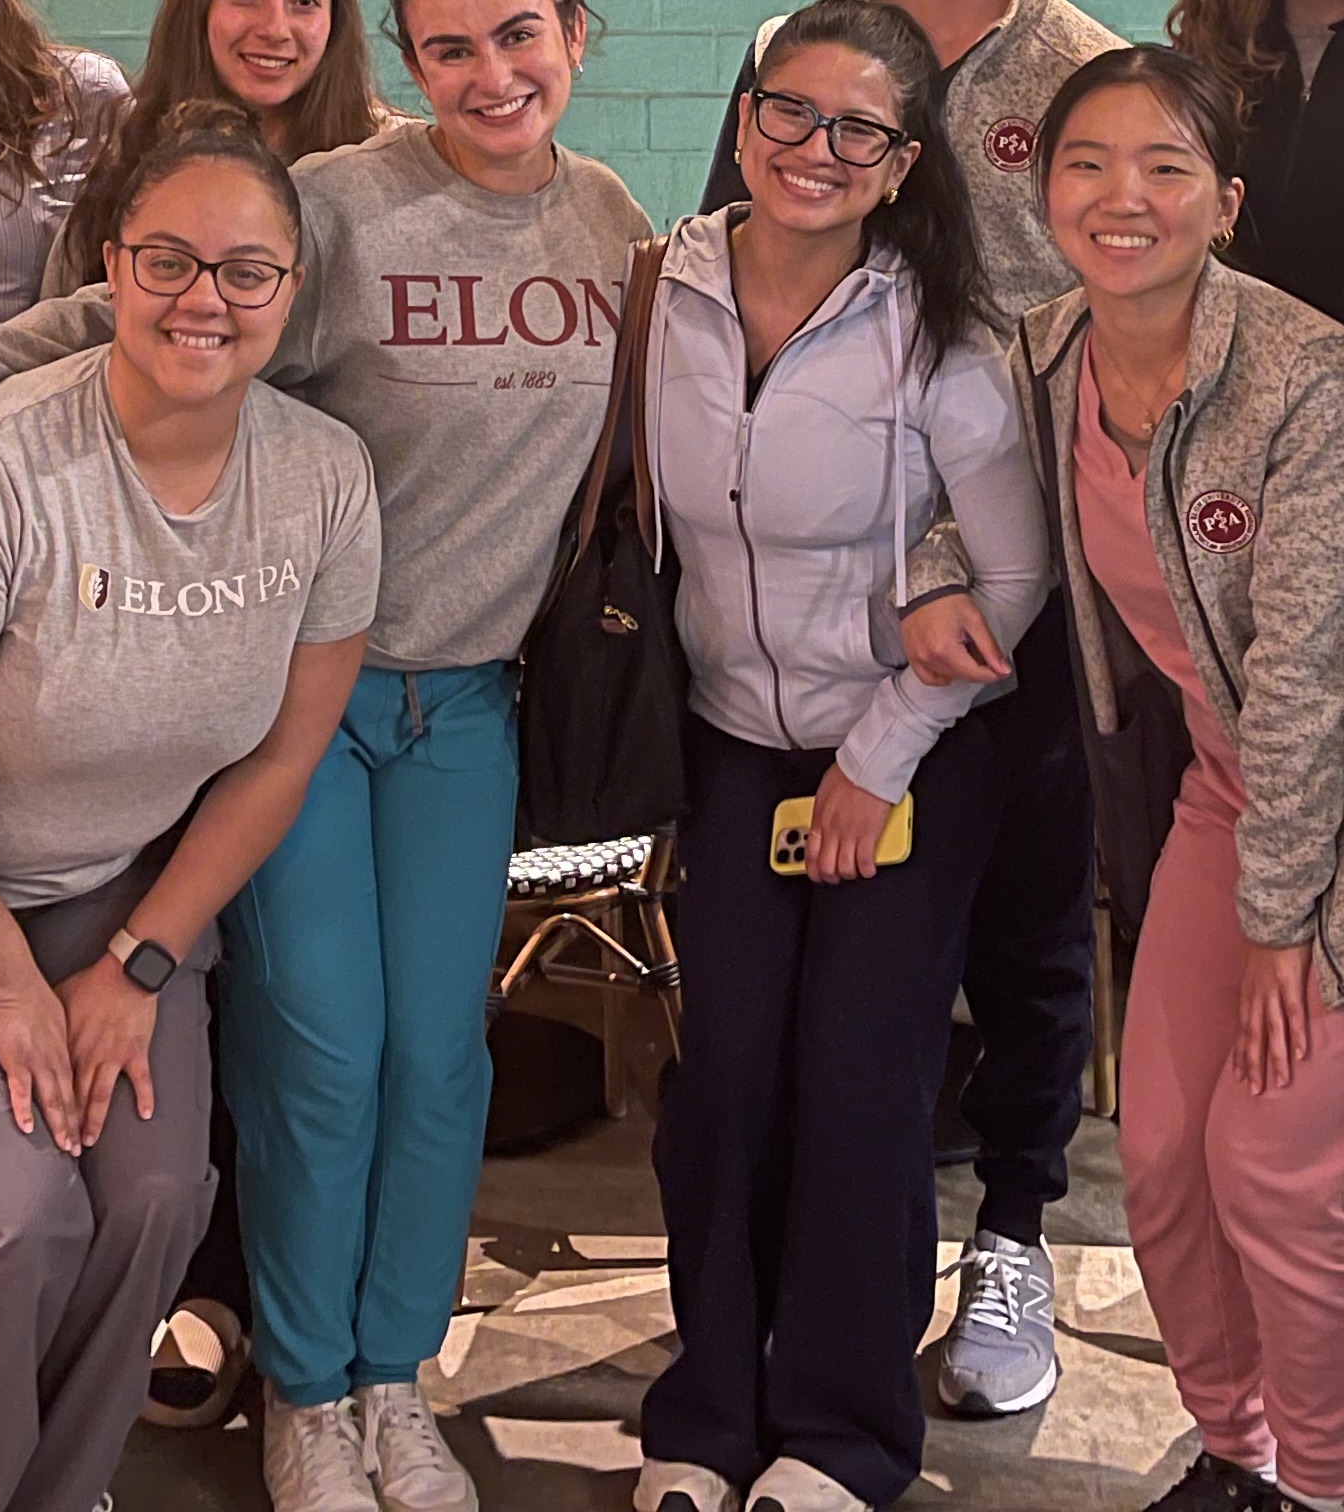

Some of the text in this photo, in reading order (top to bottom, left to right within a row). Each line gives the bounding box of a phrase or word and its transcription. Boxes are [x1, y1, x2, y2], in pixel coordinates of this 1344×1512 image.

[379, 274, 625, 348] ELON
[520, 370, 557, 389] 1889
[118, 558, 301, 617] ELON PA
